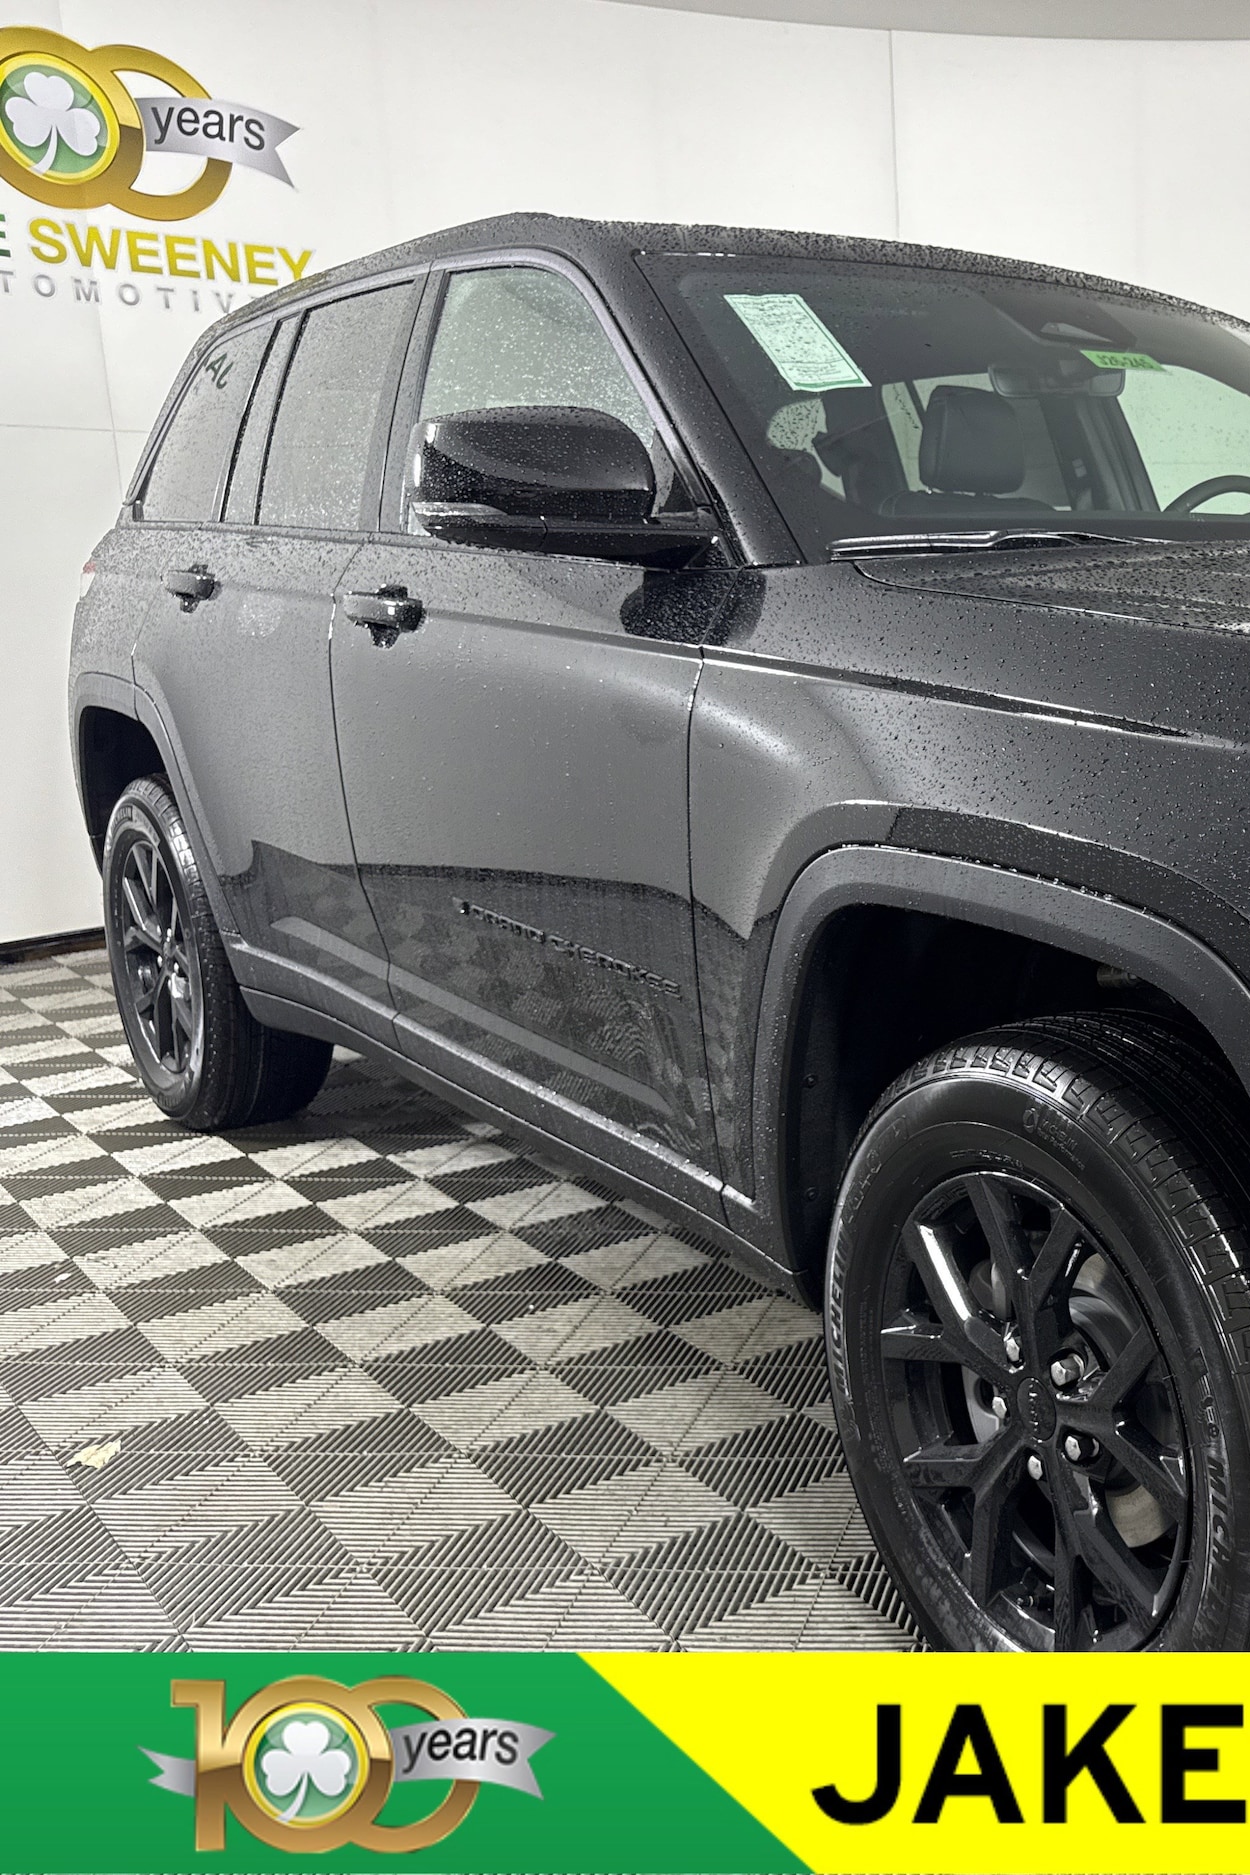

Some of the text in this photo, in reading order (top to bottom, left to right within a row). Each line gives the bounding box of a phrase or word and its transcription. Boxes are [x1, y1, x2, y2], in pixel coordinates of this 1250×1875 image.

[0, 26, 233, 222] 00
[150, 104, 266, 152] years
[28, 217, 314, 287] SWEENEY
[0, 270, 258, 314] TOMOTIV
[829, 1216, 850, 1397] MICHELIN
